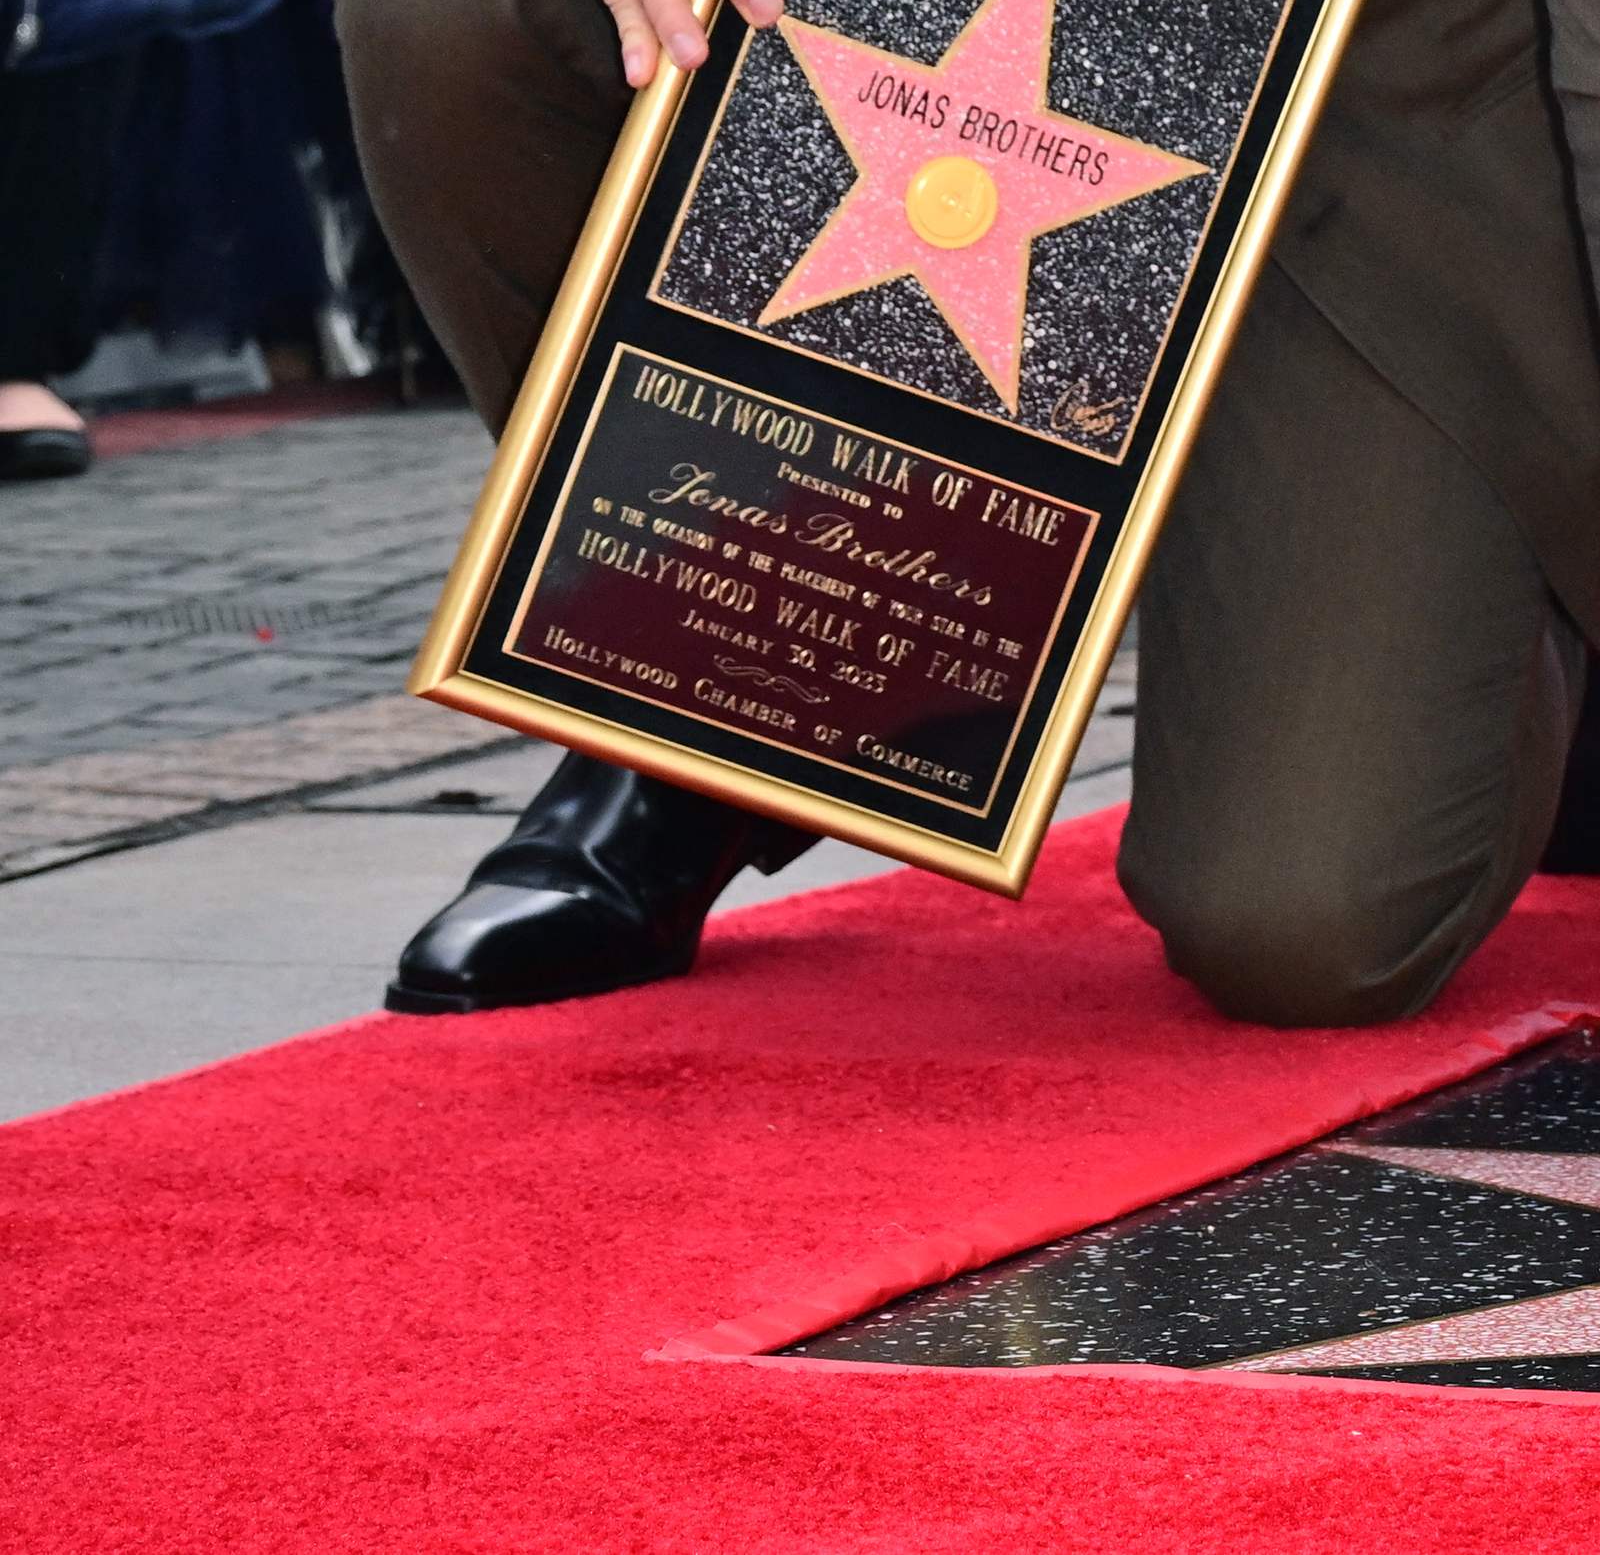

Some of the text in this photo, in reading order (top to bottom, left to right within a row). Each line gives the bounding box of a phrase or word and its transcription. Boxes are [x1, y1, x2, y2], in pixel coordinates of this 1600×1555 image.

[857, 70, 1109, 187] JONAS BROTHERS
[632, 365, 1066, 546] HOLLYWOOD WALK OF FAME
[620, 505, 647, 528] THE
[653, 517, 716, 551] OCCASION
[722, 542, 743, 560] OF
[749, 552, 775, 574] THE
[780, 562, 857, 601] PLACEMENT
[862, 590, 882, 609] OF
[929, 615, 966, 640] STAR
[996, 636, 1024, 659] THE
[648, 462, 993, 606] Jonas Brothers
[576, 528, 1010, 702] HOLLYWOOD WALK OF FAME
[680, 608, 776, 656] JANUARY
[829, 660, 889, 695] 2023
[543, 624, 679, 691] HOLLYWOOD
[693, 676, 798, 731] CHAMBER
[855, 733, 974, 792] COMMERCE
